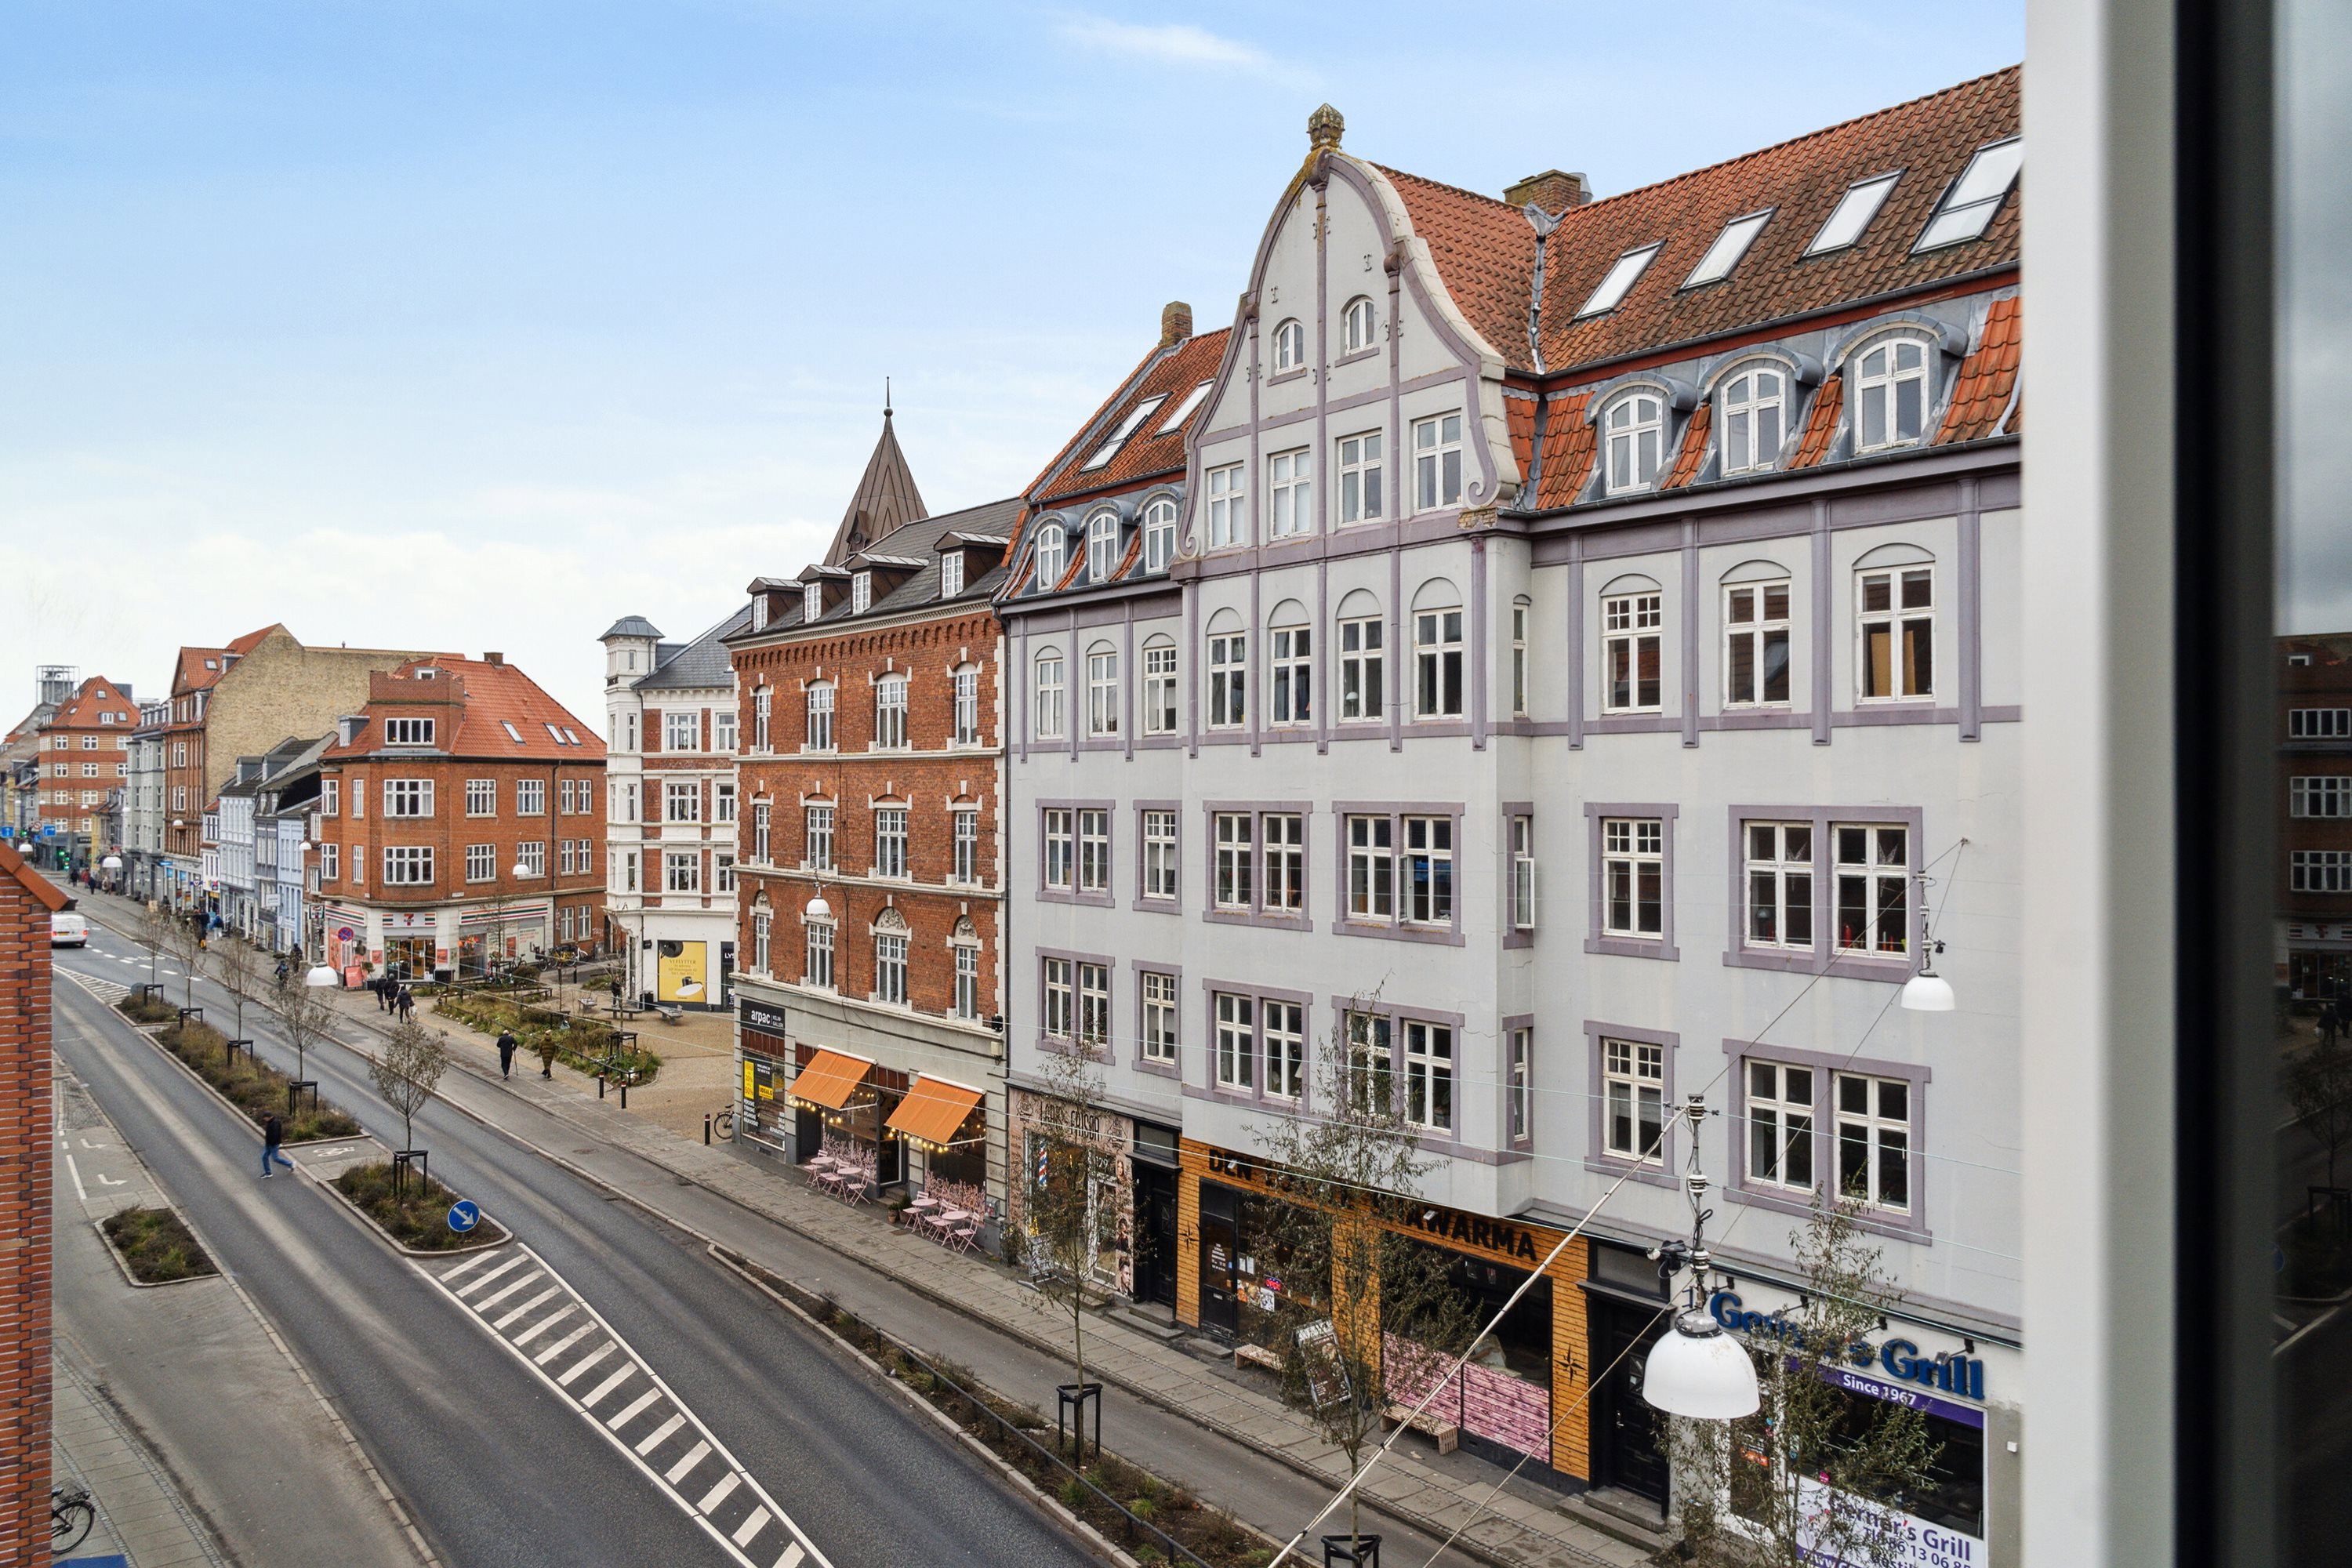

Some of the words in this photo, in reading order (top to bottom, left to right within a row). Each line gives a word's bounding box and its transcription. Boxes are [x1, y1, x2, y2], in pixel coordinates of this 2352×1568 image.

[751, 1010, 771, 1025] arpac
[1881, 1338, 1985, 1400] Grill
[1842, 1374, 1880, 1396] Since
[1882, 1385, 1918, 1406] 1967
[1911, 1544, 1927, 1561] 13
[1930, 1552, 1950, 1568] 06
[1922, 1528, 1971, 1562] Grill
